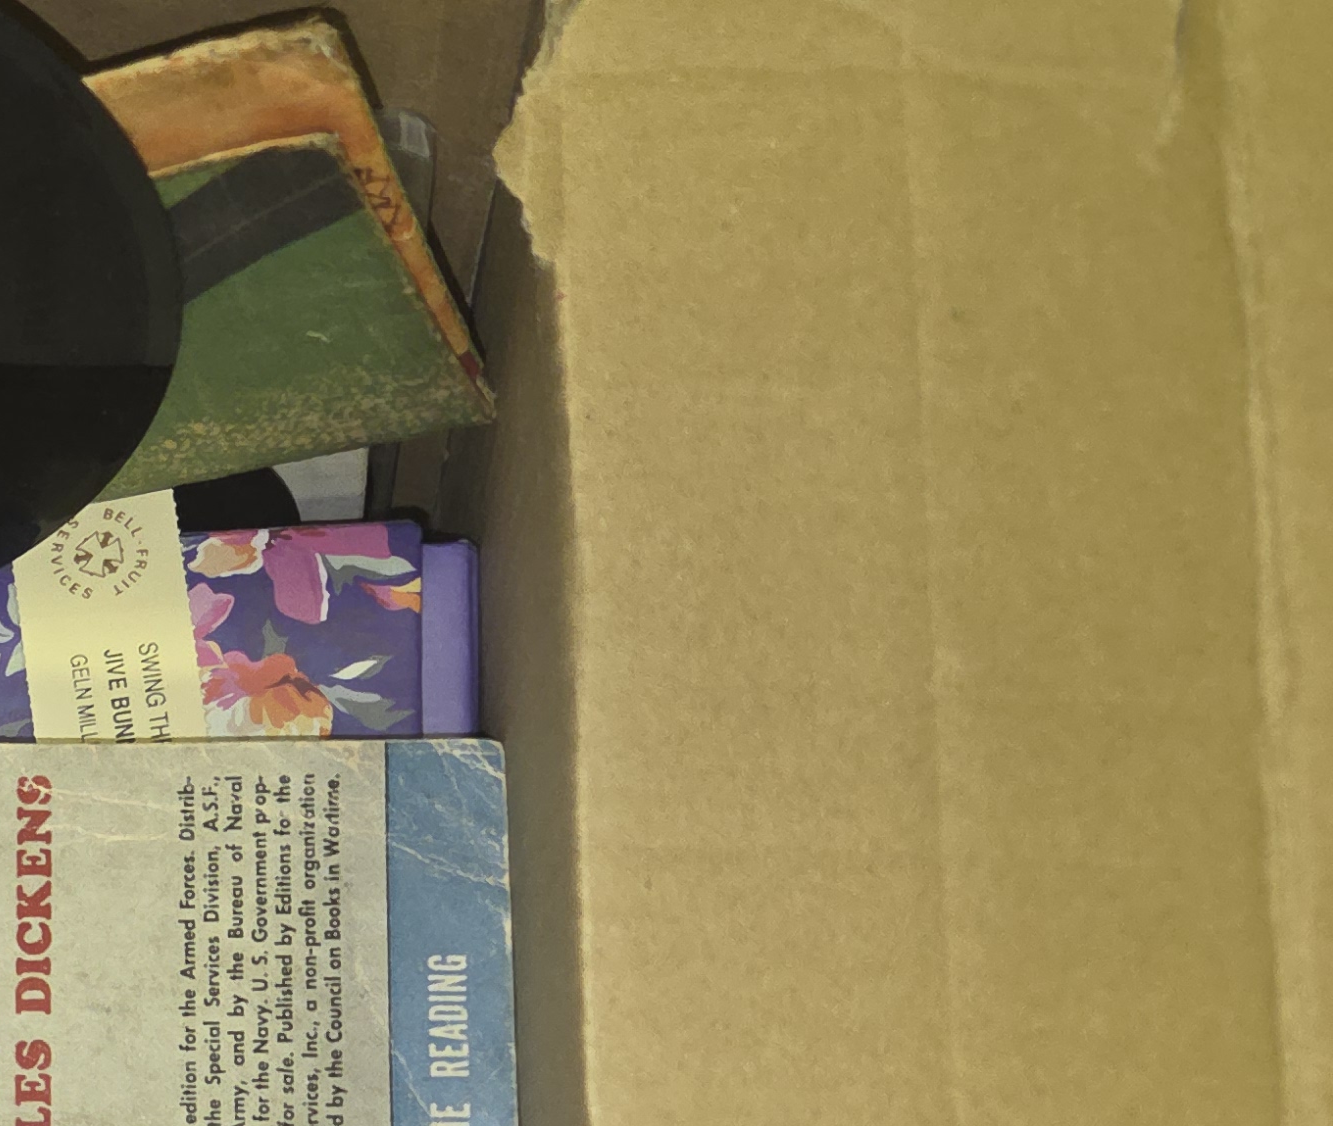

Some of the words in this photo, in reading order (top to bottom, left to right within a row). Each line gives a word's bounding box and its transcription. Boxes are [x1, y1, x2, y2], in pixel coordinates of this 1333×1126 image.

[50, 518, 93, 600] SERVICES
[70, 653, 92, 700] GELN
[103, 648, 129, 692] JIVE
[138, 642, 167, 708] SWING
[177, 776, 195, 840] Distrib-
[273, 775, 291, 803] the
[225, 844, 242, 862] of
[298, 773, 320, 889] organization
[15, 774, 54, 1015] DICKENS
[179, 851, 195, 909] Forces.
[203, 846, 221, 922] Division,
[251, 832, 268, 942] Government
[275, 844, 292, 915] Editions
[324, 864, 341, 881] in
[227, 876, 243, 938] Bureau
[323, 888, 341, 940] Books
[178, 920, 196, 979] Armed
[274, 923, 296, 946] by
[298, 900, 321, 989] non-profit
[331, 947, 341, 969] on
[203, 936, 220, 1006] Services
[227, 952, 243, 980] the
[179, 989, 196, 1016] the
[227, 994, 248, 1016] by
[275, 955, 293, 1043] Published
[307, 1000, 317, 1011] a
[324, 976, 343, 1043] Council
[428, 953, 470, 1077] READING
[179, 1027, 196, 1052] for
[227, 1030, 244, 1066] and
[252, 999, 272, 1053] Navy.
[203, 1022, 226, 1085] Special
[251, 1061, 269, 1090] the
[275, 1052, 294, 1094] sale.
[325, 1050, 343, 1077] the
[180, 1062, 197, 1124] edition
[204, 1099, 221, 1126] the
[252, 1096, 270, 1121] for
[326, 1085, 348, 1107] by
